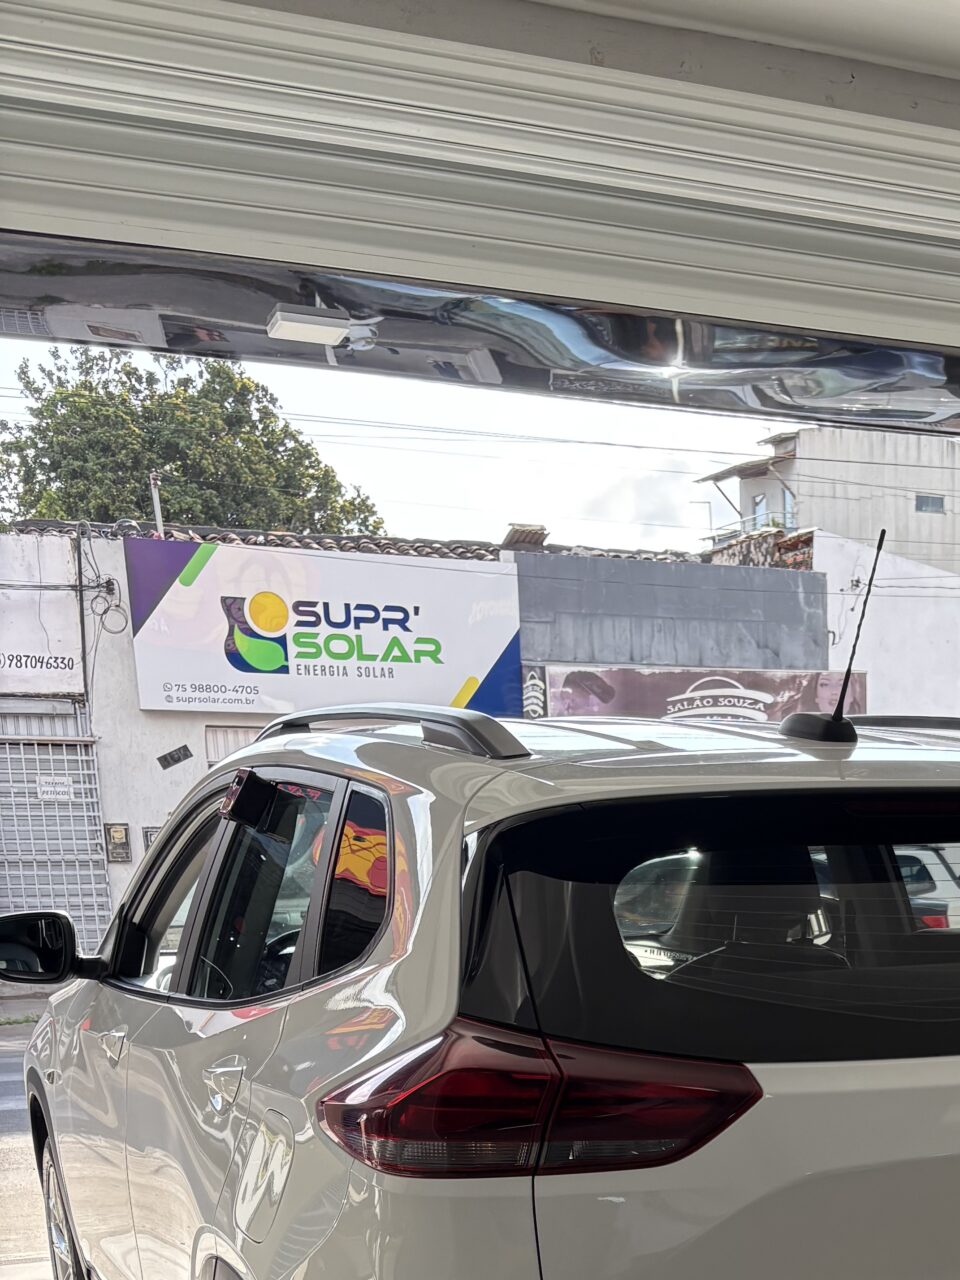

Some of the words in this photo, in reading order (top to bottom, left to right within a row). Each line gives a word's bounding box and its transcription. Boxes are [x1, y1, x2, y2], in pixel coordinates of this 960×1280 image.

[292, 600, 420, 632] SUPR'
[292, 632, 445, 664] SOLAR
[0, 652, 74, 670] )987046330
[296, 664, 349, 677] ENERGIA
[356, 666, 395, 679] SOLAR
[174, 684, 187, 693] 75
[190, 683, 260, 695] 98800-4705
[175, 695, 256, 705] suprsolar.com.br
[667, 696, 713, 713] SALÃO
[718, 698, 766, 711] SOUZA
